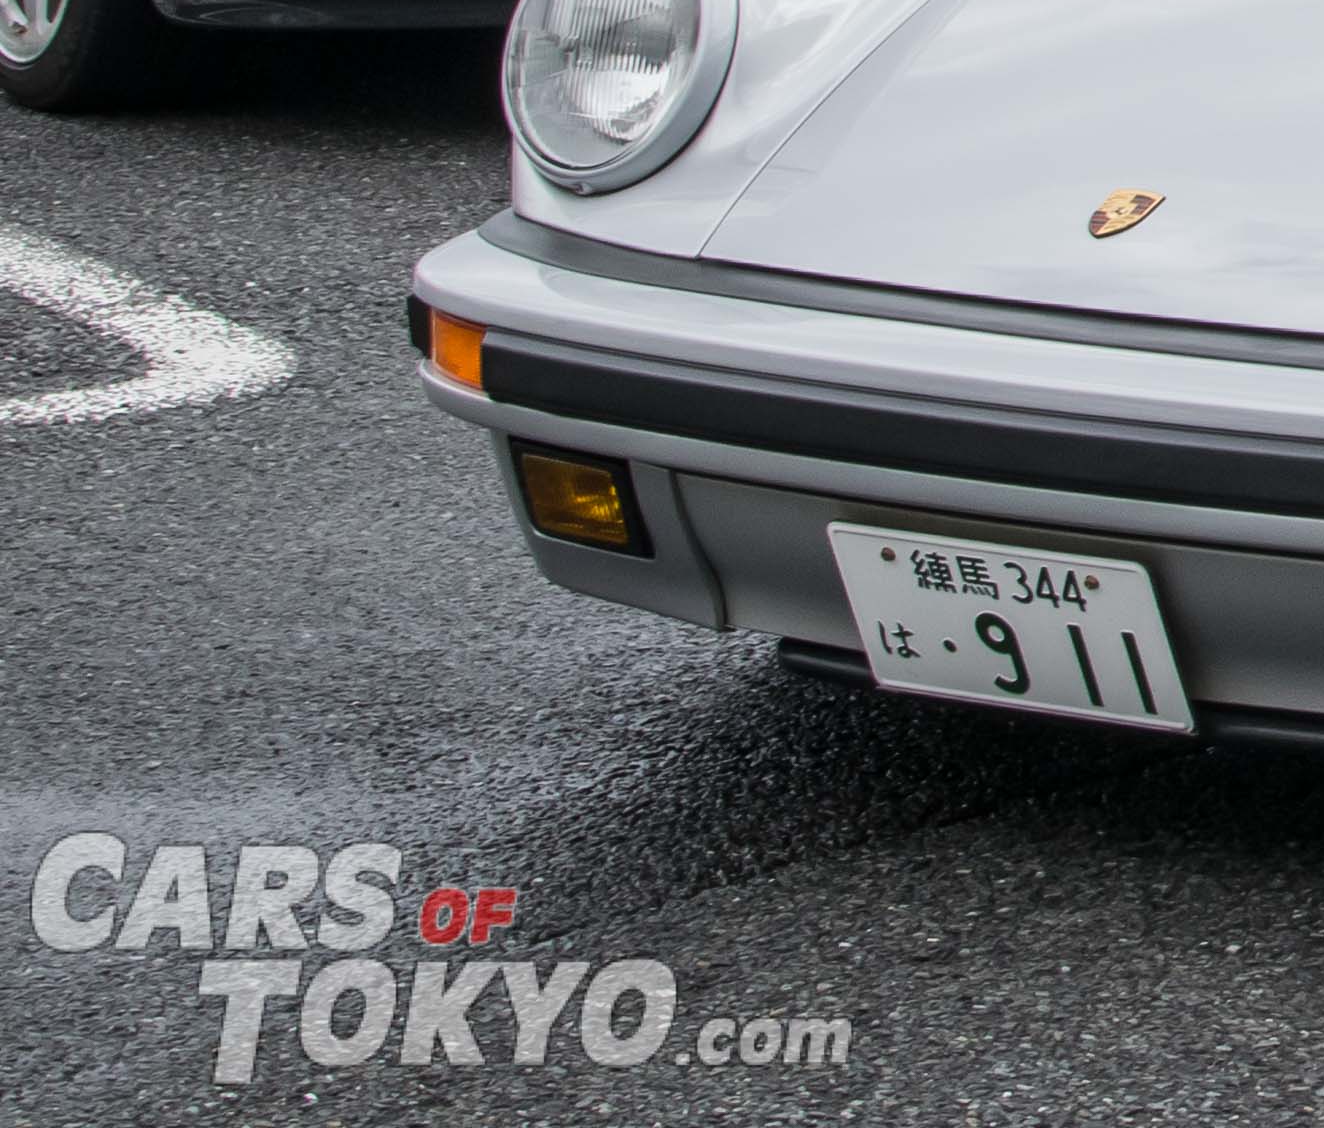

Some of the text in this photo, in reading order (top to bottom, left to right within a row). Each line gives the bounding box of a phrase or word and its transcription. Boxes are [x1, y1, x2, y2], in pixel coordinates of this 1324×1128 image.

[910, 550, 1087, 612] 練馬 344
[878, 619, 920, 659] は
